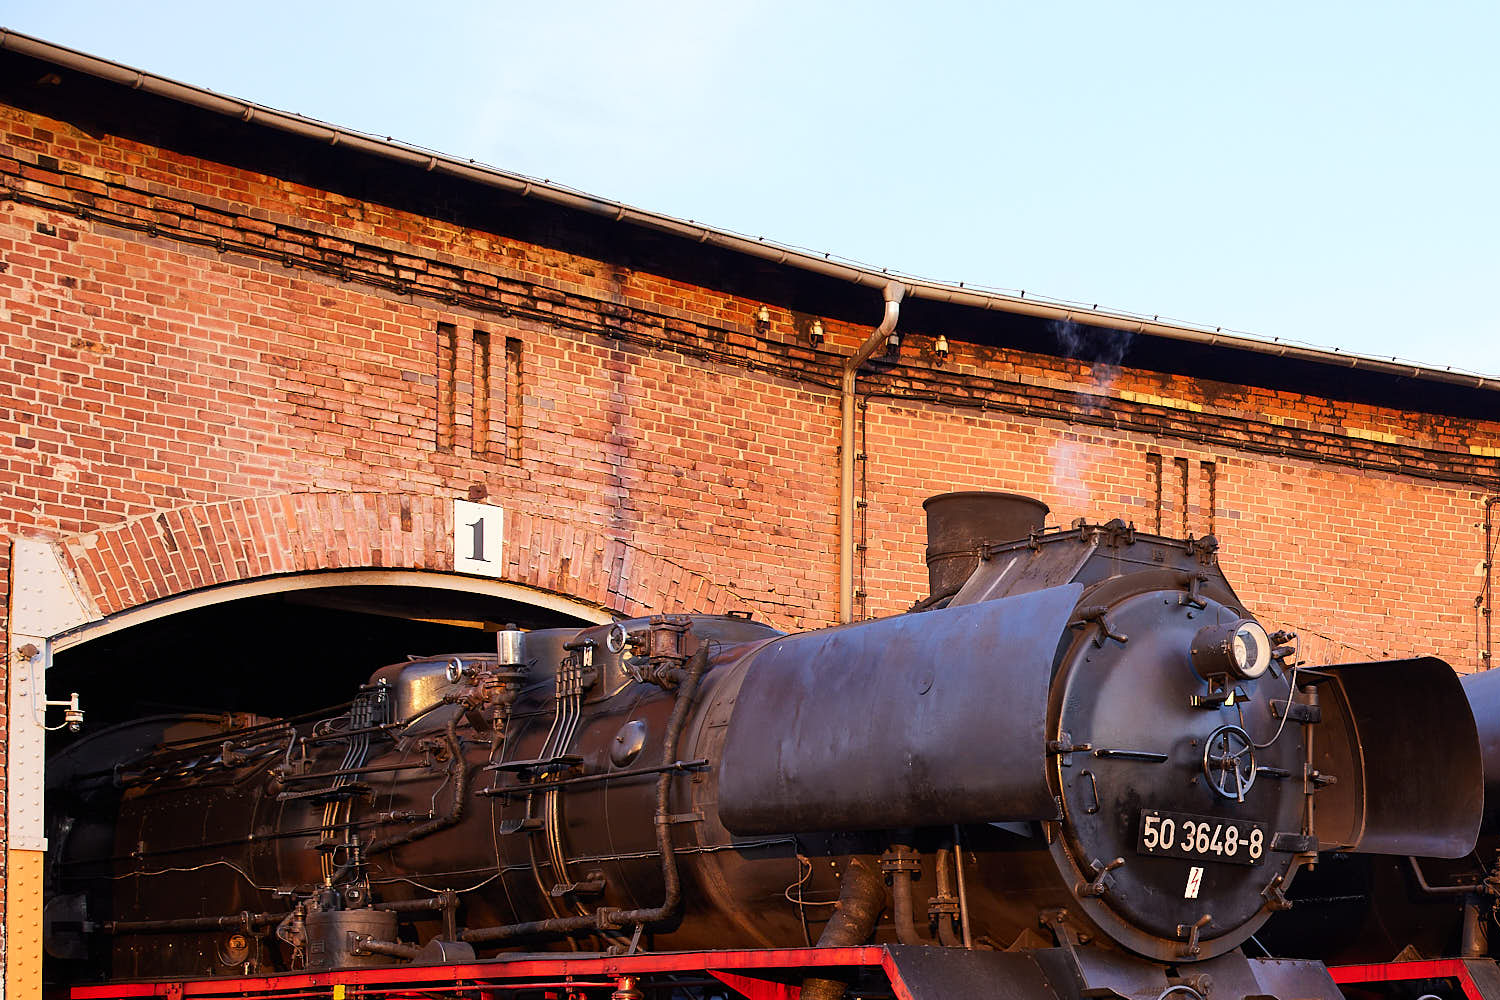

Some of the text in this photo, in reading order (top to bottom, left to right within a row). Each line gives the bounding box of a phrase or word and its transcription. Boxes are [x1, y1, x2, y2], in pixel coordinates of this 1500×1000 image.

[464, 517, 492, 563] 1
[1143, 815, 1264, 859] 50 3648-8
